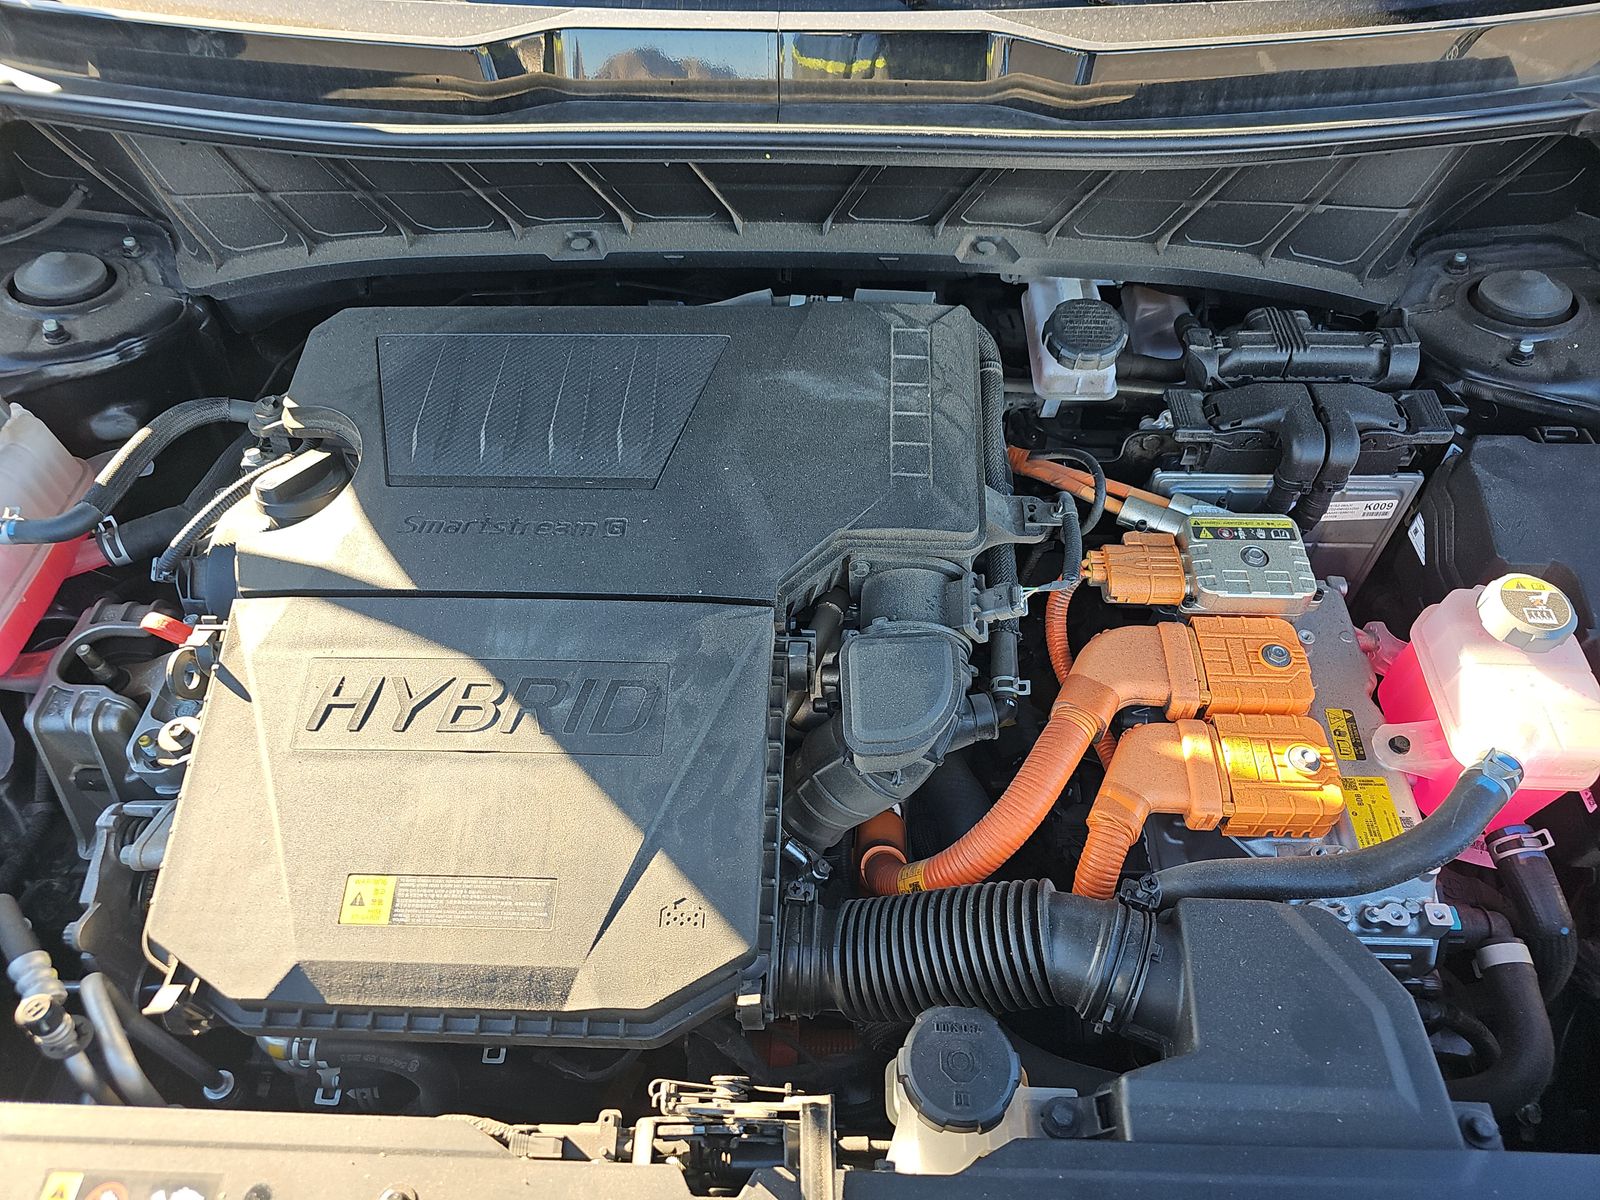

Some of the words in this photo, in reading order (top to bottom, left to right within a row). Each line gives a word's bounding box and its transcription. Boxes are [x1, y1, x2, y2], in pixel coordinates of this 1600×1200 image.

[1363, 502, 1394, 511] K009
[397, 515, 599, 537] Smartstream
[304, 675, 661, 736] HYBRID
